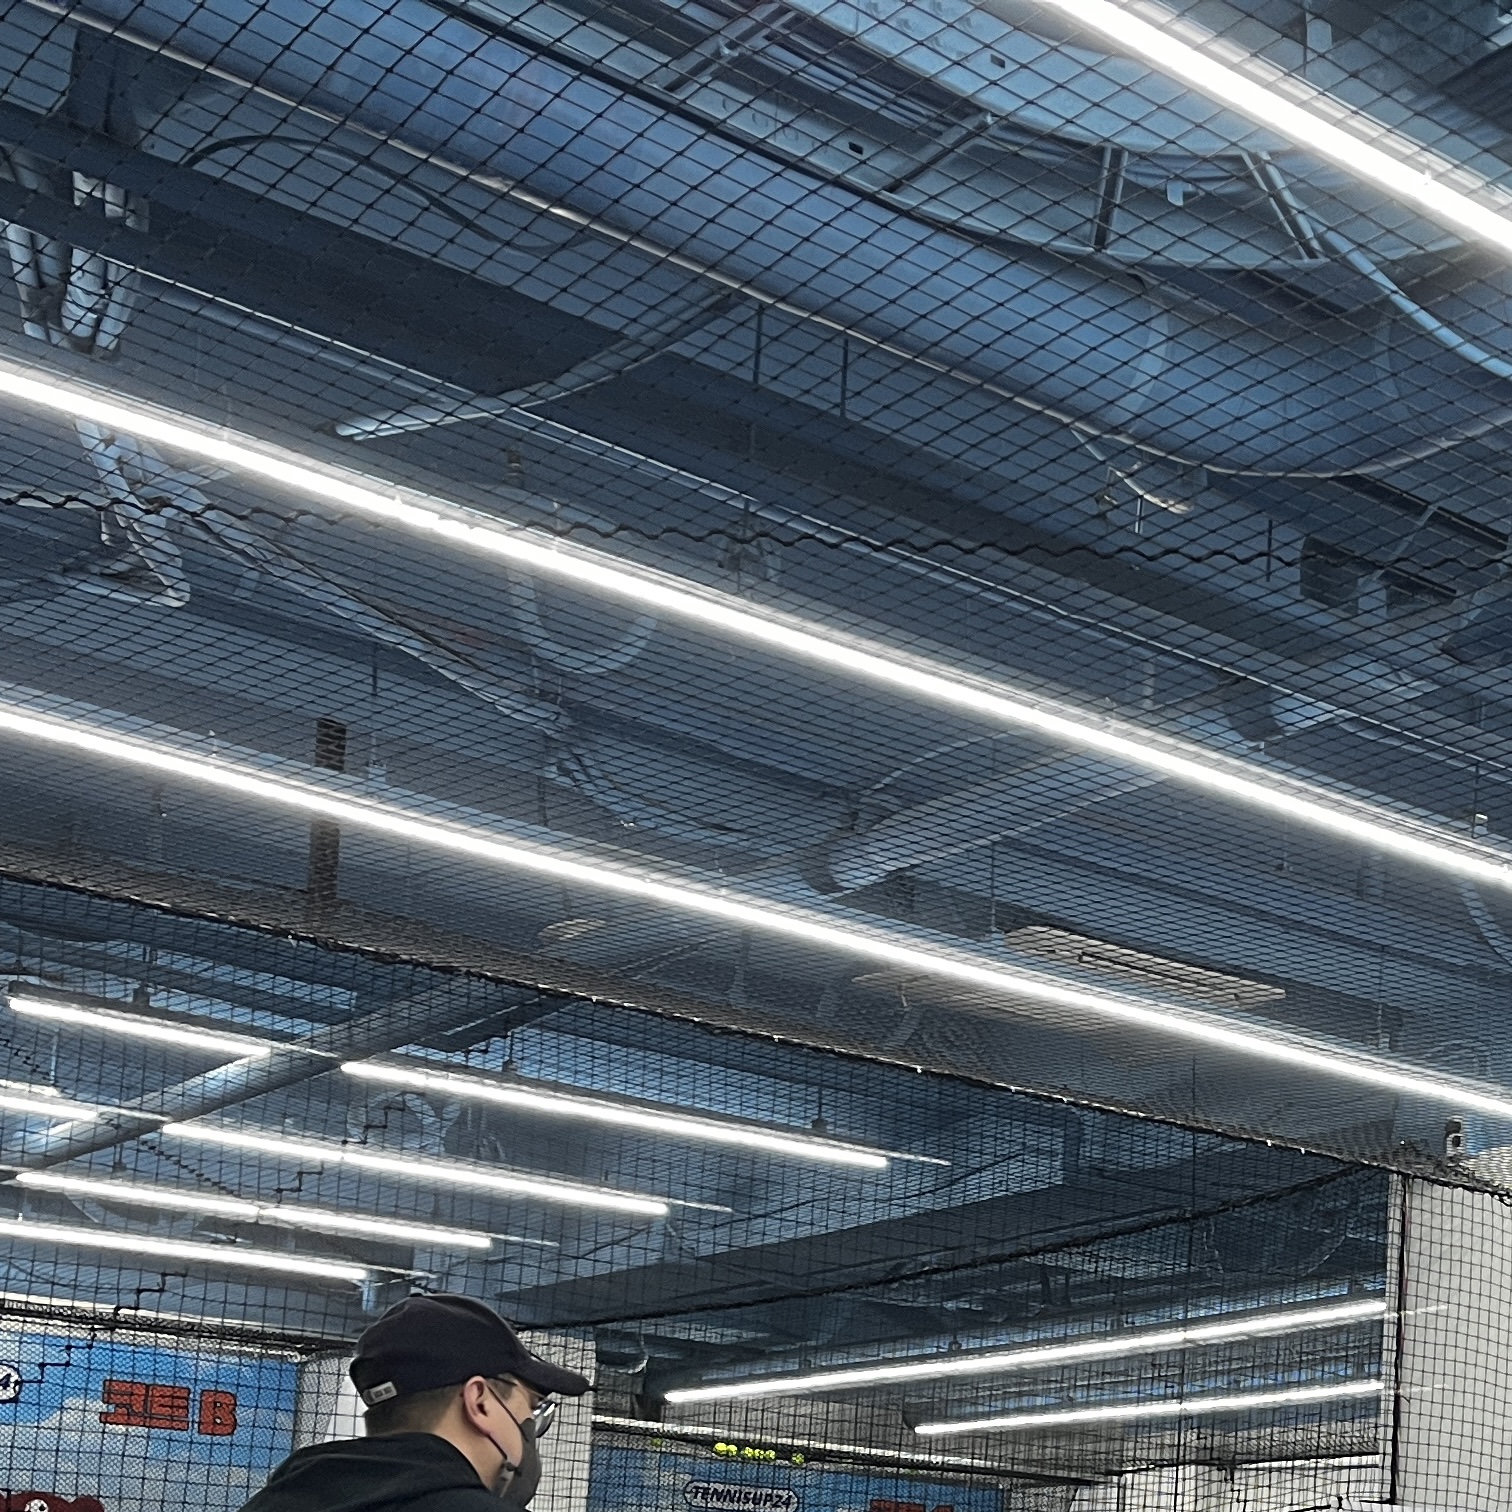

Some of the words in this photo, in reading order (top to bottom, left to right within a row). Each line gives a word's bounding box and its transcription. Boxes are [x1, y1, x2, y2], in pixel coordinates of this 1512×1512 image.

[100, 1380, 190, 1431] 코트
[199, 1389, 237, 1436] B
[688, 1484, 793, 1511] TENNISUP24
